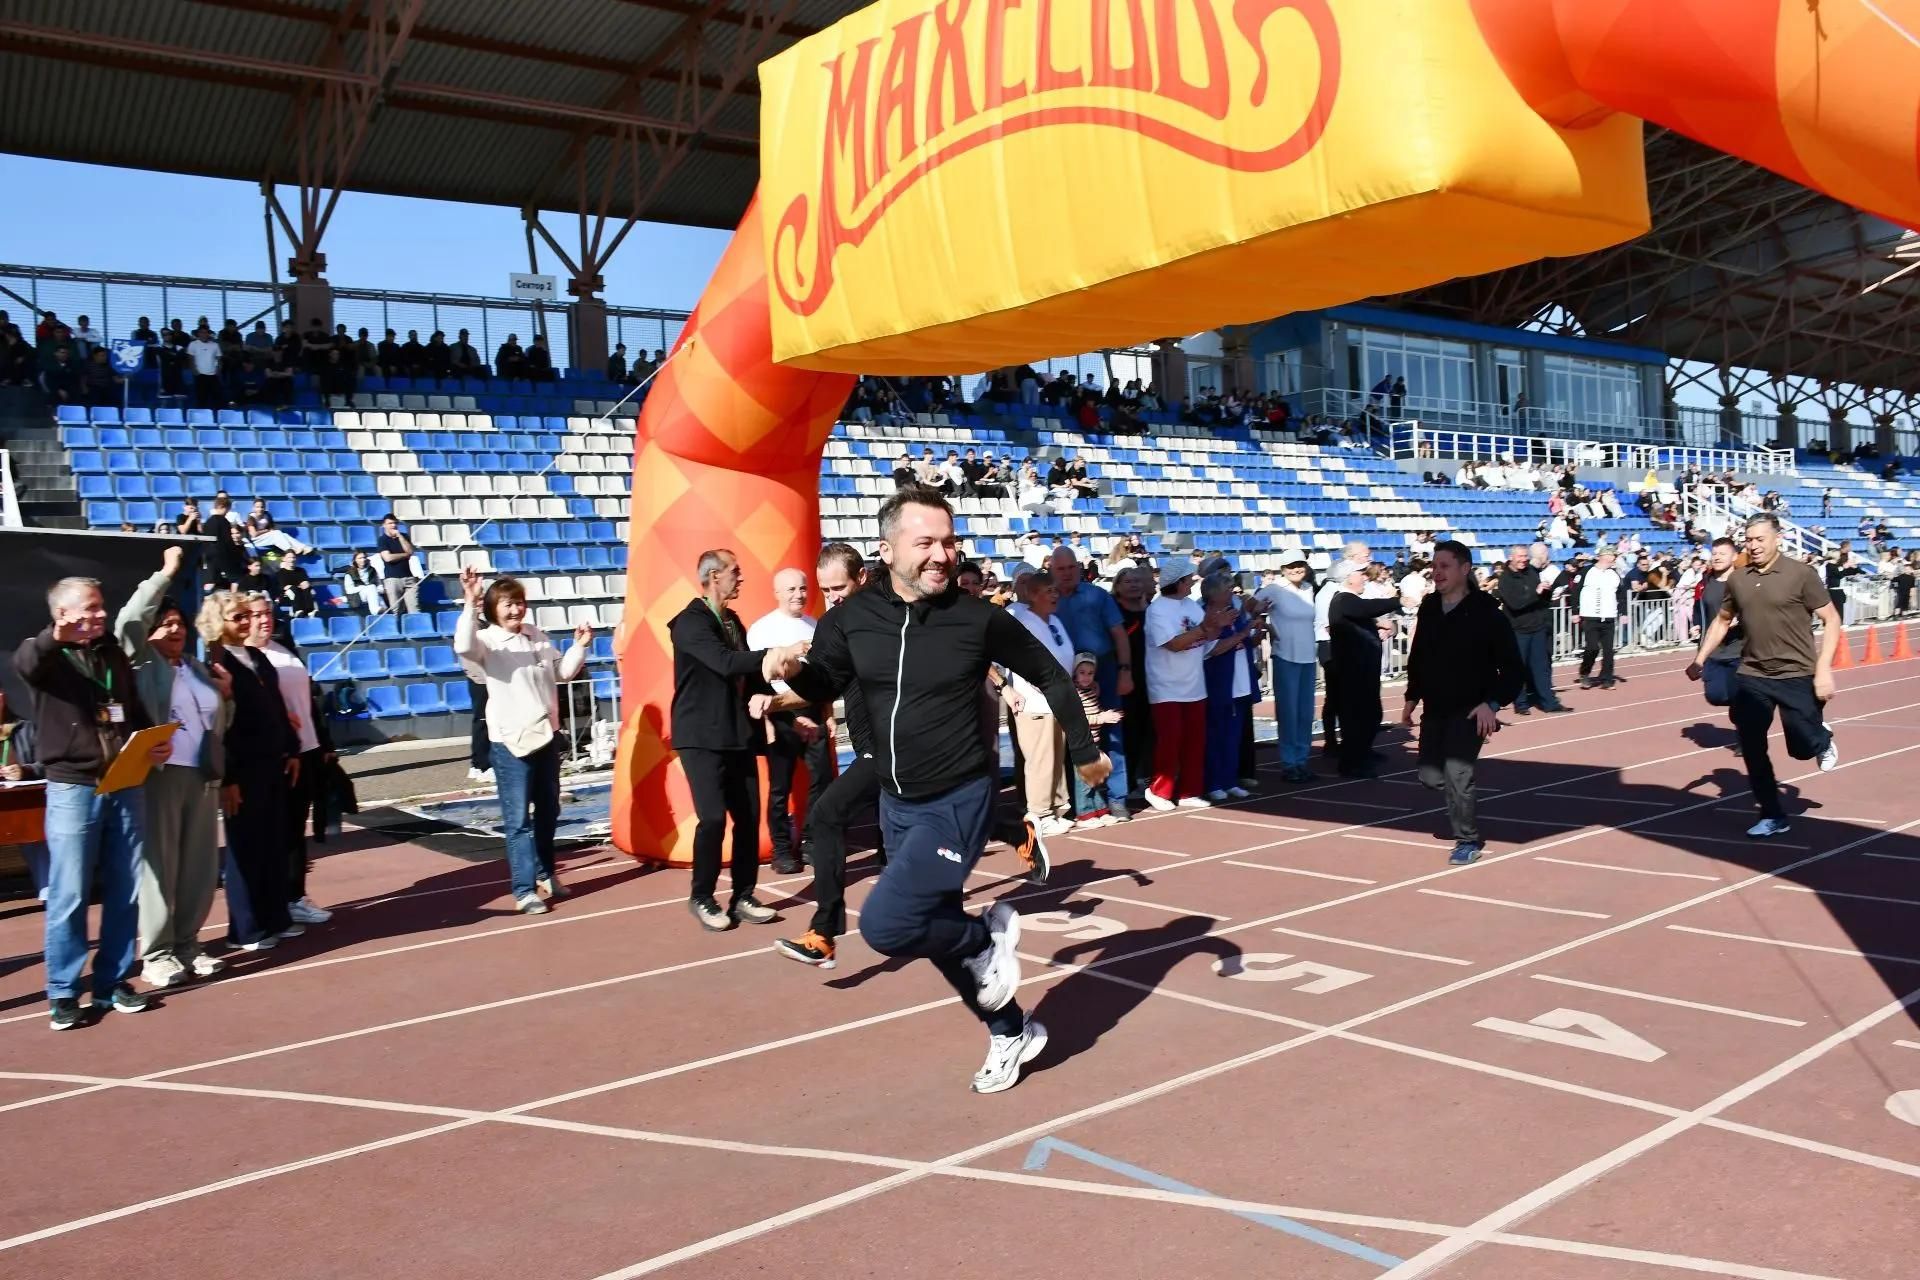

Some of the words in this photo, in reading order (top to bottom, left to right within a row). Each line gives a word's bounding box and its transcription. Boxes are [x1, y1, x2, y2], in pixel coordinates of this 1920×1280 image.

[515, 279, 545, 292] Сектор
[546, 281, 553, 291] 2
[1211, 952, 1375, 995] 5
[1471, 1007, 1669, 1063] 4
